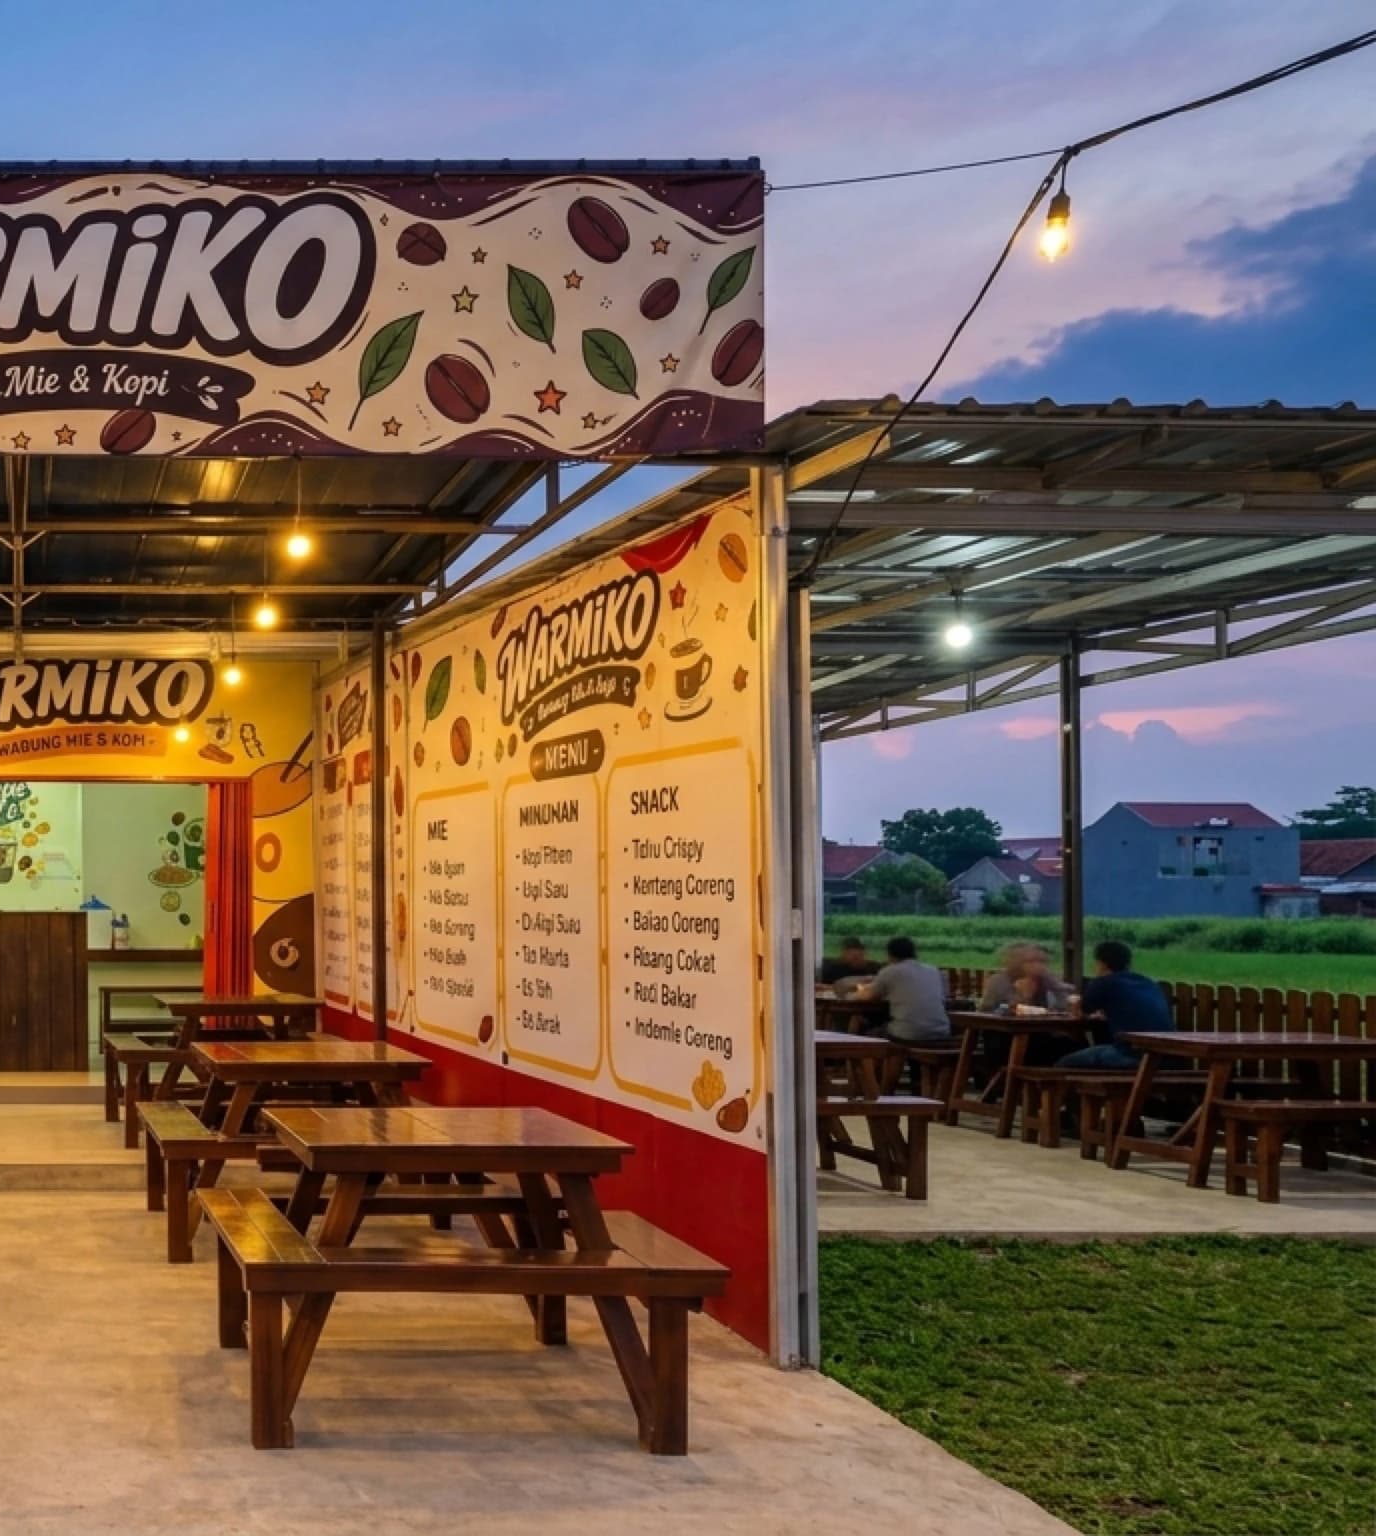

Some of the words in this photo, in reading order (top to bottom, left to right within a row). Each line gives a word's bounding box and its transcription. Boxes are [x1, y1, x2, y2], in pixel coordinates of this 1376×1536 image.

[4, 365, 61, 397] Mie
[70, 364, 90, 393] &
[101, 363, 170, 406] Kopi
[544, 738, 589, 771] MENU
